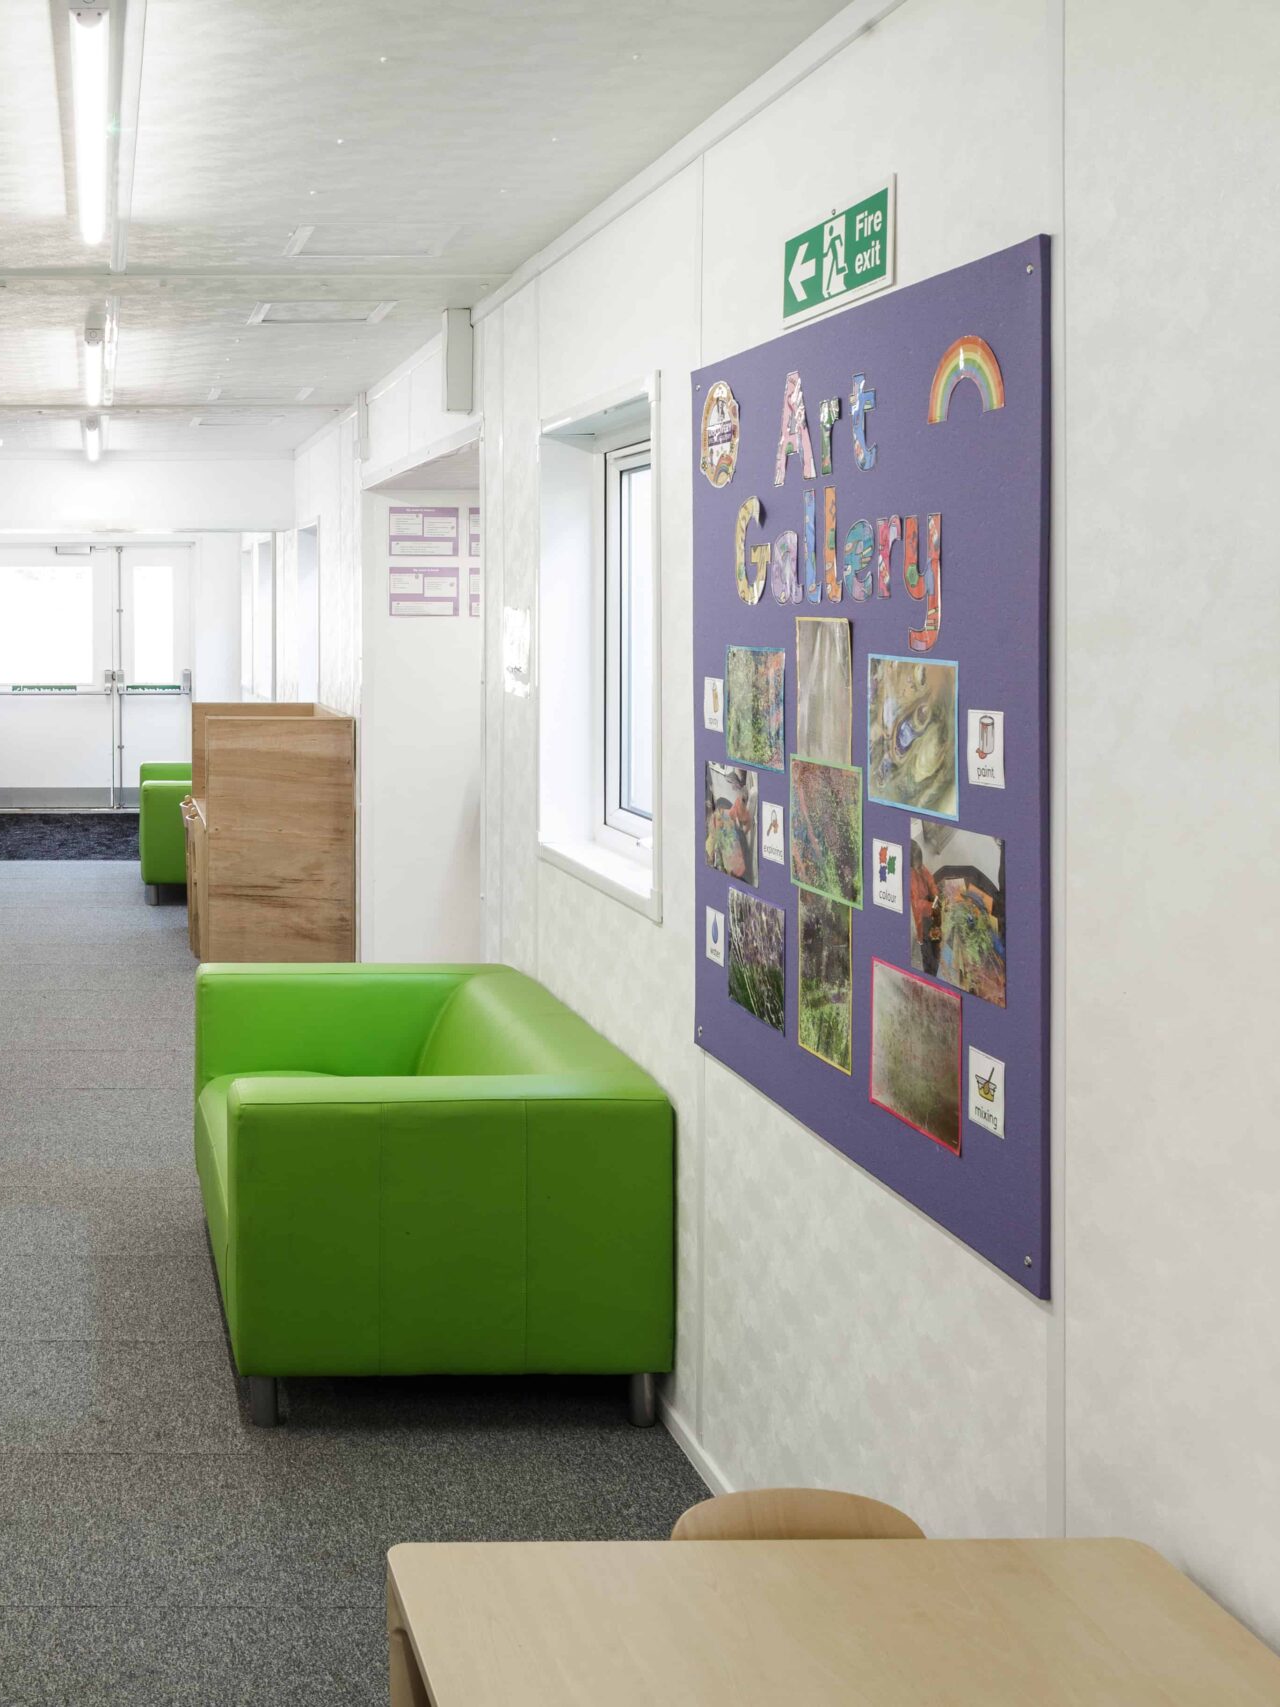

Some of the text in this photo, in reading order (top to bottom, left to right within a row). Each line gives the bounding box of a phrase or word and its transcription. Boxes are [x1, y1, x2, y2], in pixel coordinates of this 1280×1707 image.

[855, 210, 882, 242] Fire
[854, 239, 881, 274] exit
[774, 371, 876, 487] Art
[735, 485, 941, 652] Gallery
[976, 764, 995, 780] paint
[879, 889, 897, 904] colour
[974, 1105, 998, 1130] mixing
